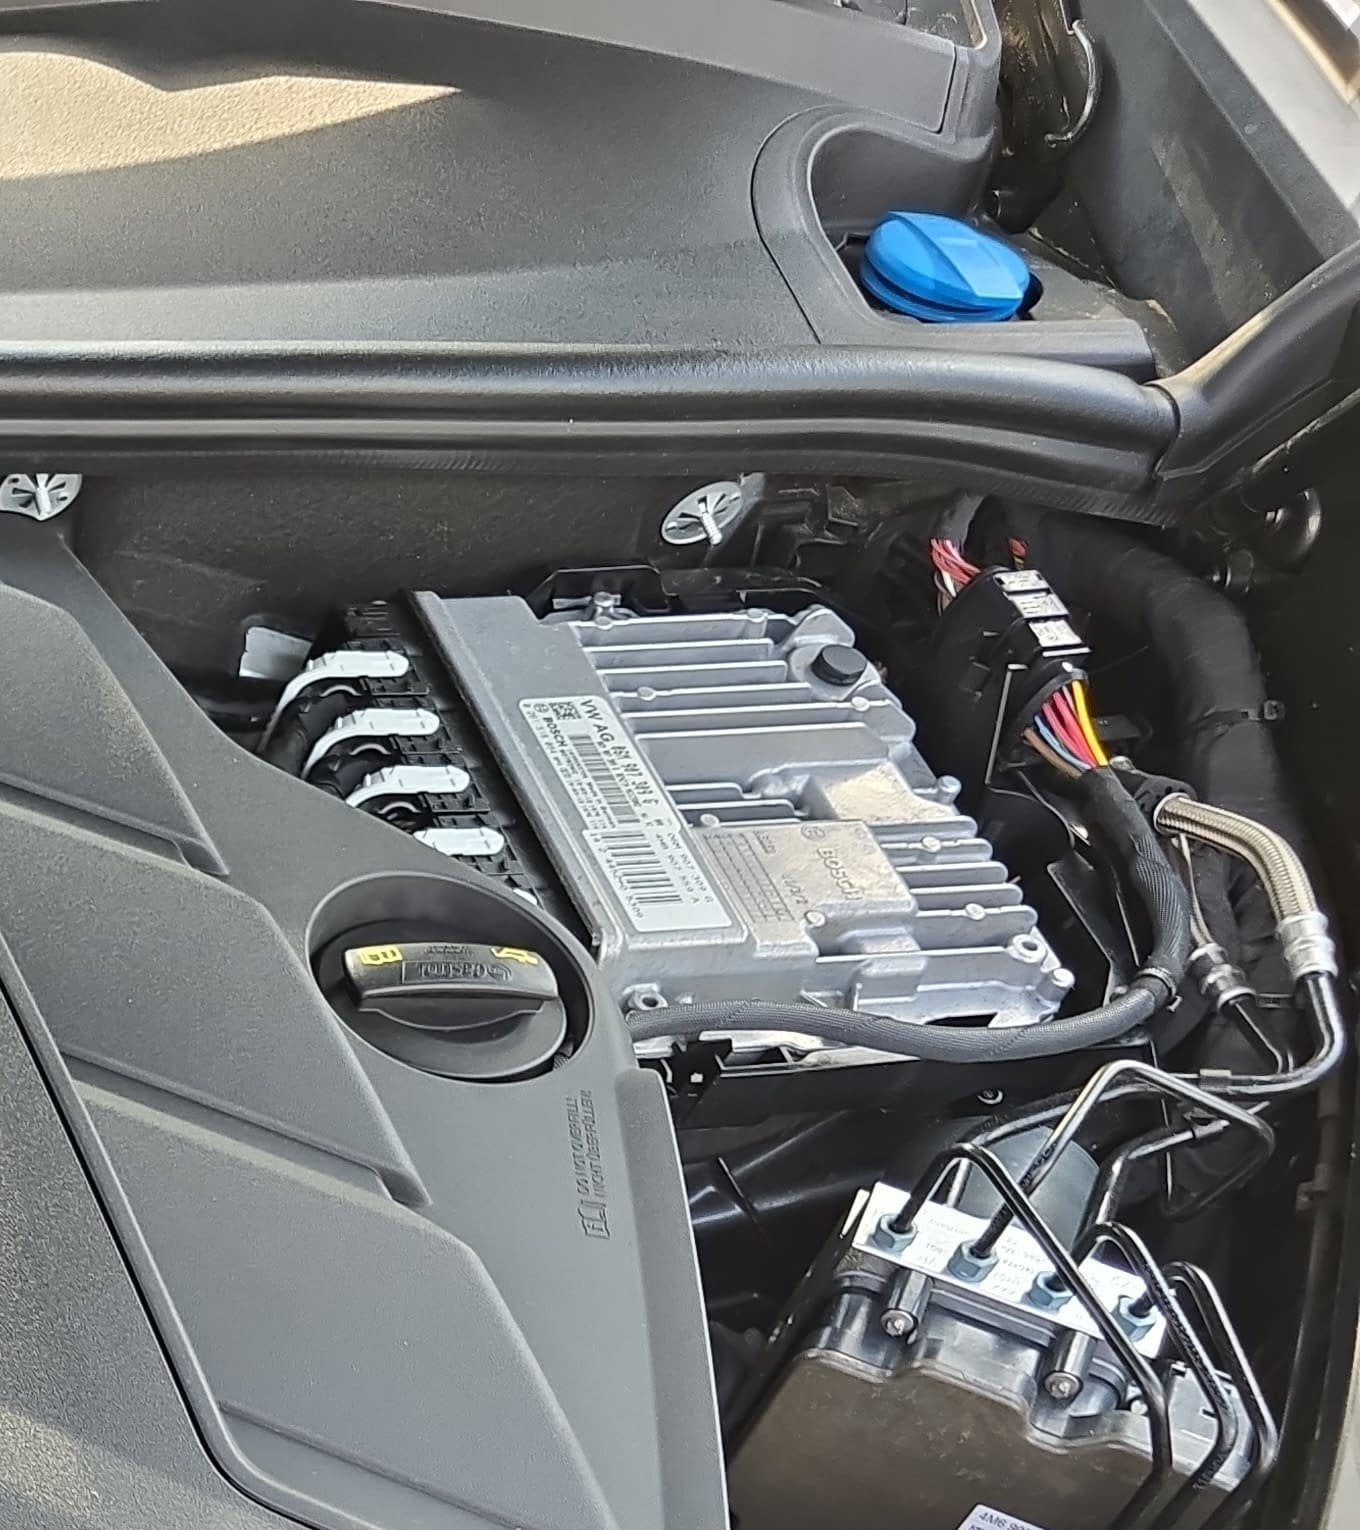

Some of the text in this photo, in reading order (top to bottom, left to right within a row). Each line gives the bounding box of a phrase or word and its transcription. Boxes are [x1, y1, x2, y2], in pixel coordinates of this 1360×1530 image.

[543, 717, 568, 747] BOSCH
[580, 699, 603, 721] VW
[593, 723, 615, 742] AG
[816, 847, 865, 902] BOSCH
[979, 1511, 1007, 1527] 4M6
